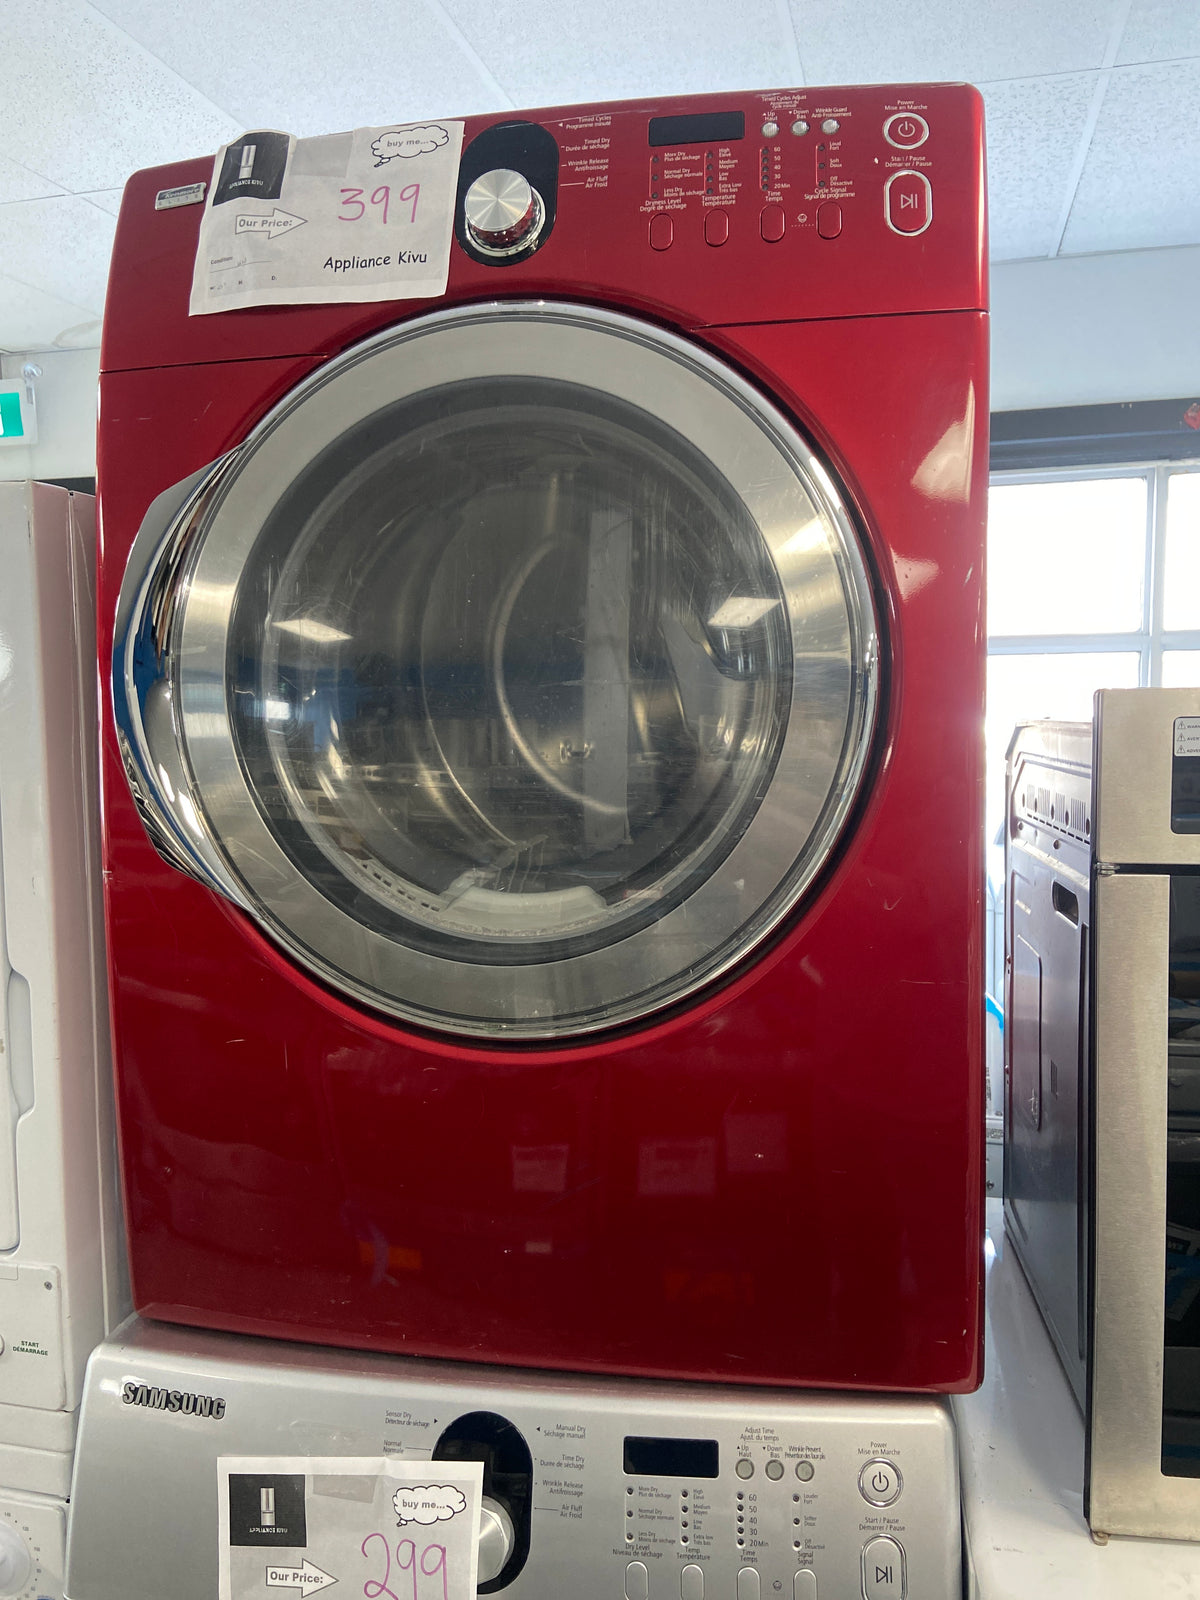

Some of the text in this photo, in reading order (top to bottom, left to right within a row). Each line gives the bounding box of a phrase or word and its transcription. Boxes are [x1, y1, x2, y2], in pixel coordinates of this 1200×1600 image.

[387, 139, 402, 148] buy
[338, 184, 420, 224] 399
[239, 218, 292, 228] Our Price:
[323, 251, 427, 272] Appliance Kivu
[13, 1346, 48, 1356] DÉMARRAGE
[122, 1382, 226, 1420] SAMSUNG
[403, 1411, 411, 1419] Dry
[576, 1455, 584, 1463] Dry
[402, 1500, 445, 1509] buy me...
[641, 1550, 663, 1559] séchage
[361, 1533, 447, 1600] 299
[270, 1572, 323, 1584] Our Price:
